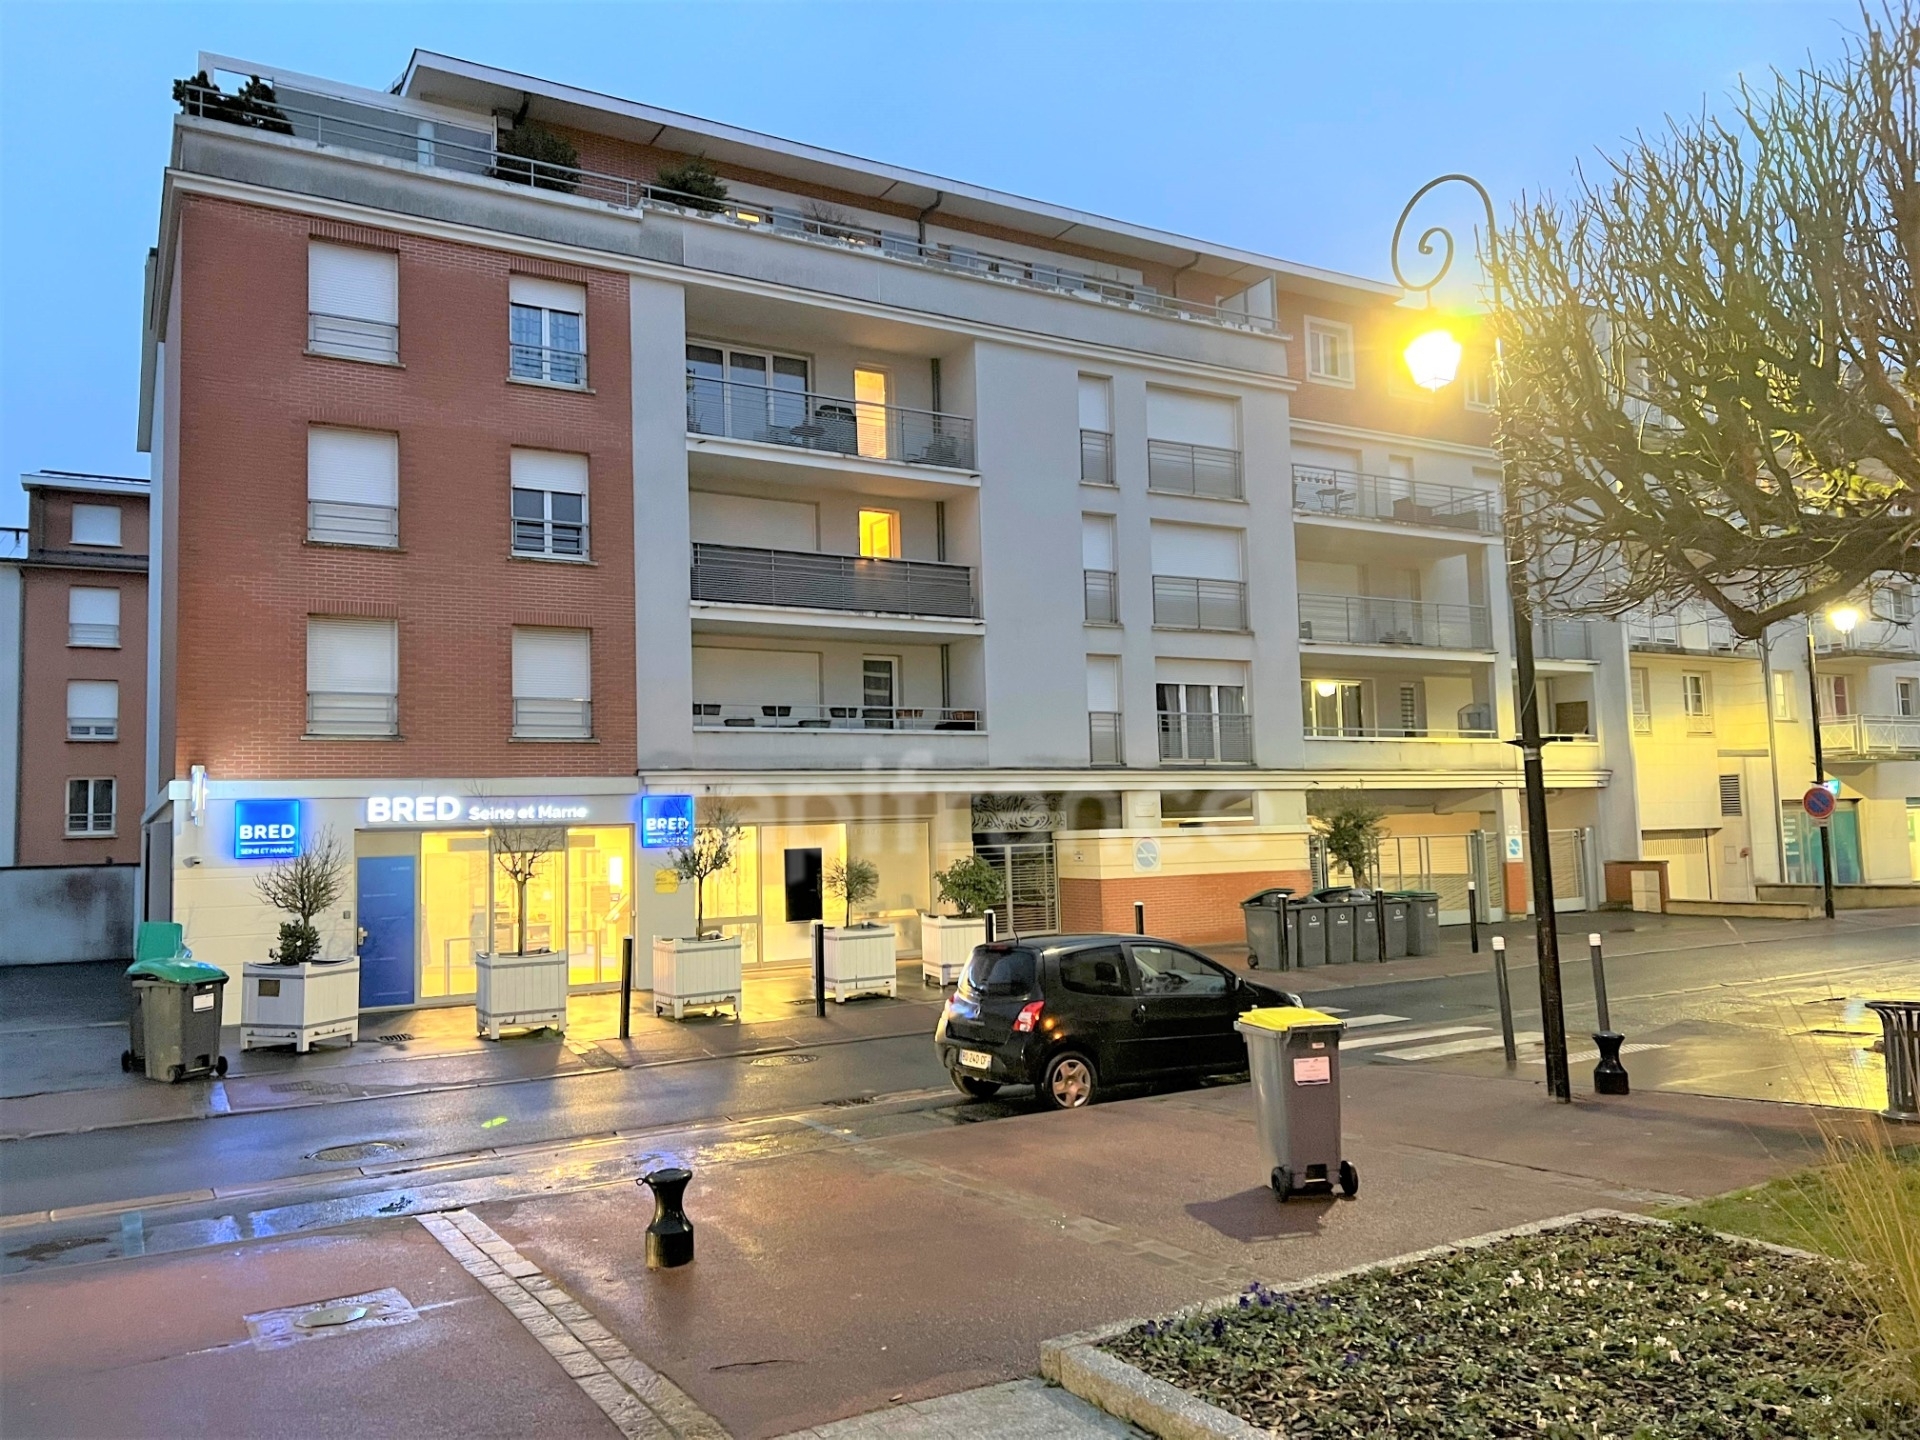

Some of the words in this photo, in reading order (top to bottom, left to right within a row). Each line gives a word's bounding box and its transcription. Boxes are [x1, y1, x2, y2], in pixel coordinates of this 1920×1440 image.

[367, 796, 461, 822] BRED
[468, 806, 514, 821] Seine
[517, 806, 535, 819] et
[537, 805, 588, 820] Marne
[645, 817, 690, 831] BRED
[239, 824, 296, 840] BRED
[240, 847, 260, 855] SEINE
